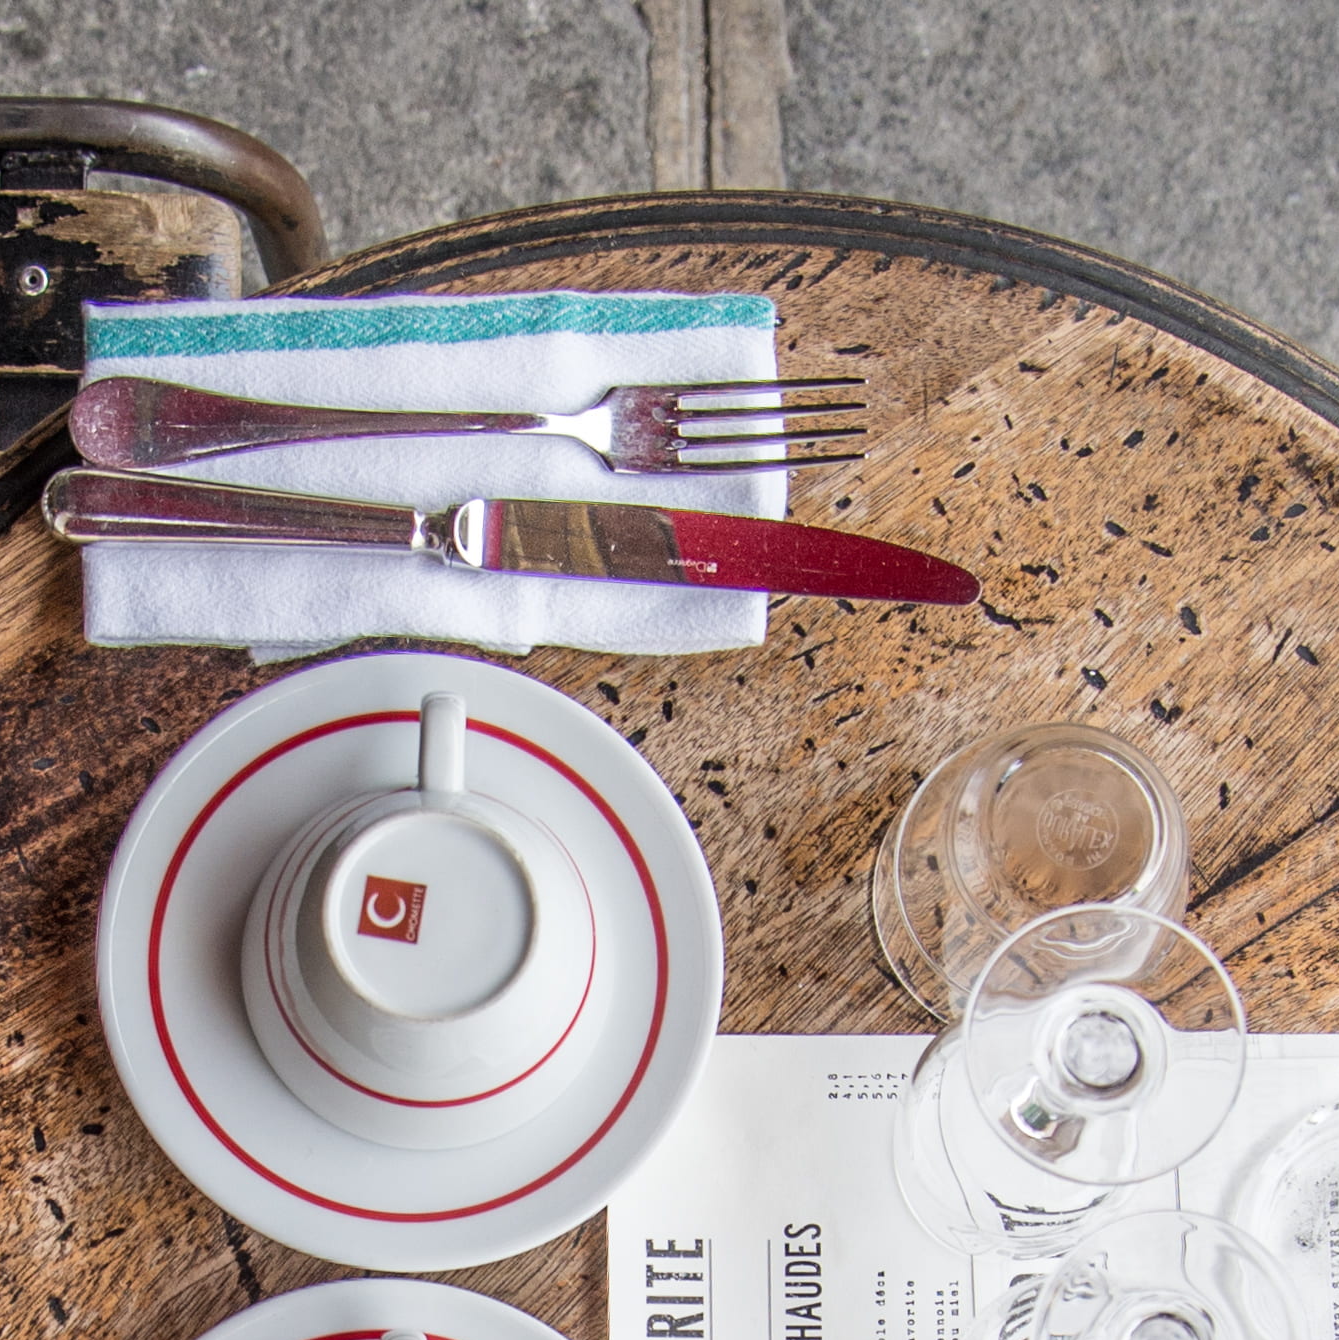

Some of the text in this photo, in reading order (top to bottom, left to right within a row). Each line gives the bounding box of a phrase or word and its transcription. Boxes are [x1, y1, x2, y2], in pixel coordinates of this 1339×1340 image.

[406, 887, 425, 941] CHOMETTE
[828, 1073, 840, 1100] 2,8
[842, 1074, 855, 1100] 4,1
[857, 1074, 870, 1100] 5,1
[872, 1072, 884, 1100] 5,6
[887, 1072, 900, 1100] 5,7
[875, 1270, 886, 1307] déca
[948, 1280, 960, 1316] miel
